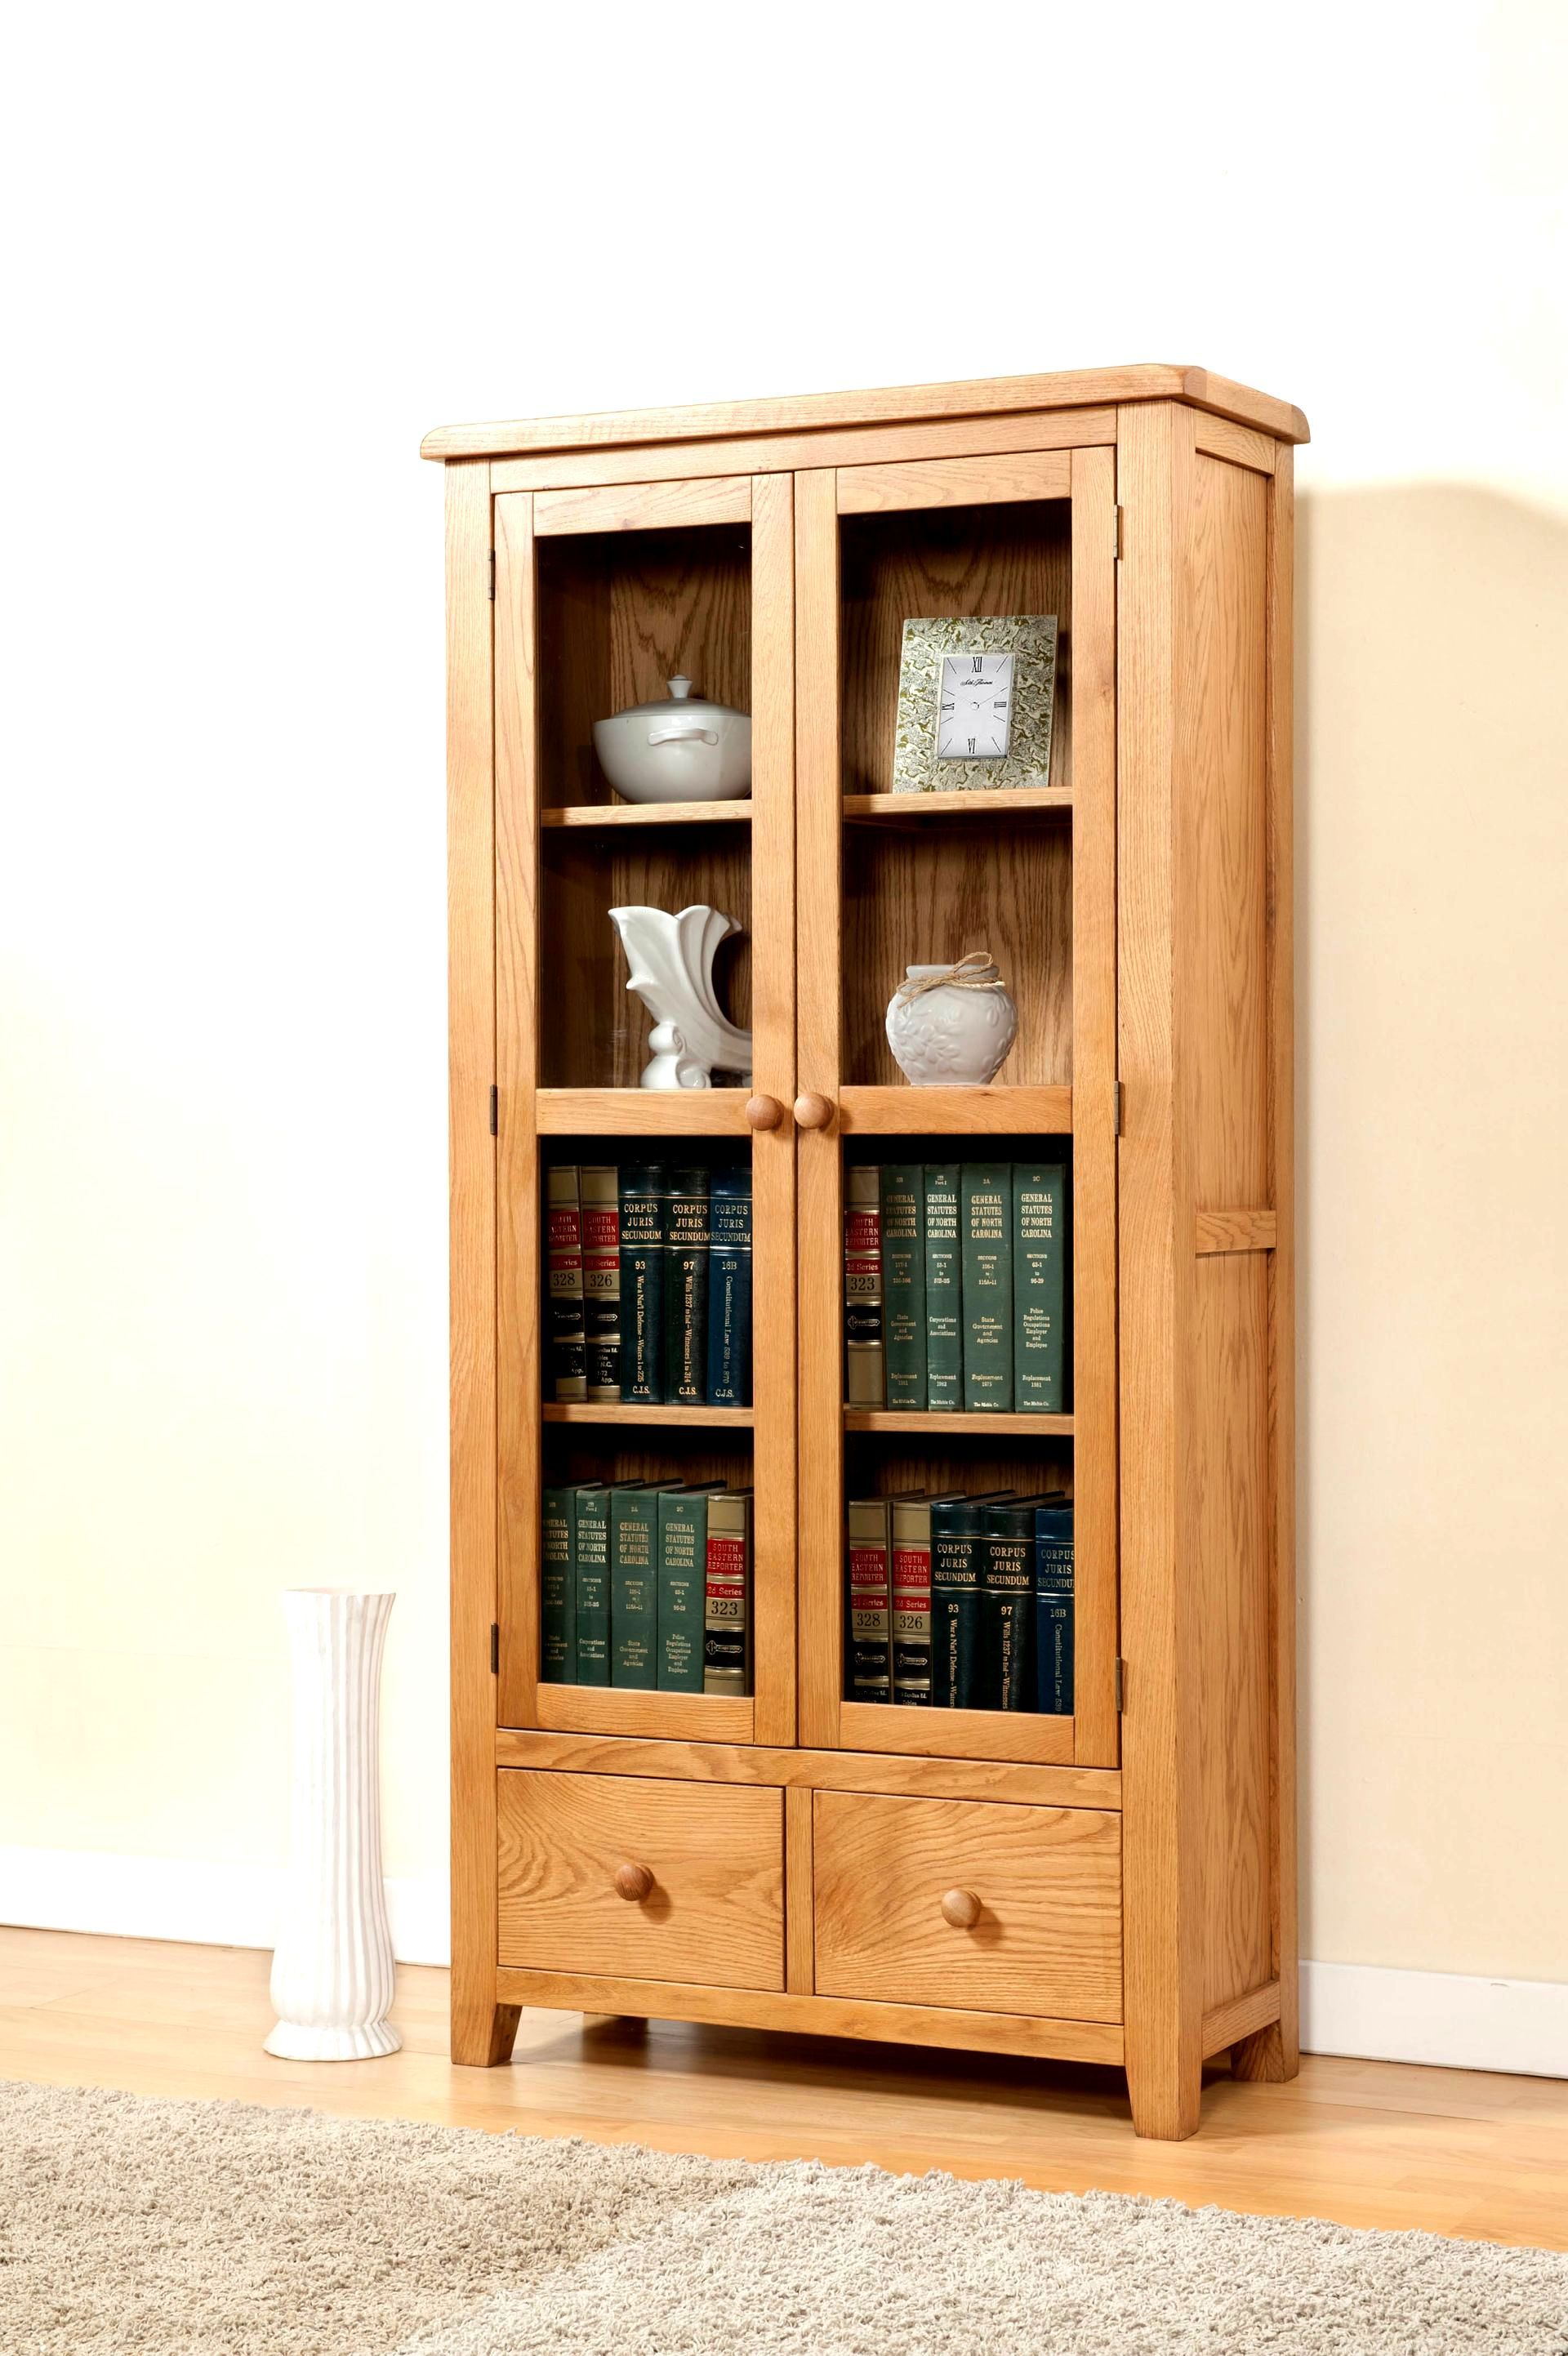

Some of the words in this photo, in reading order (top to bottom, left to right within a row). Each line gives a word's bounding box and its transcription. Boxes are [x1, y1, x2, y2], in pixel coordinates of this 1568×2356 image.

[972, 657, 982, 673] XII
[887, 1195, 915, 1203] GENERAL
[927, 1194, 957, 1203] GENERAL
[971, 1196, 1002, 1204] GENERAL
[1021, 1194, 1052, 1203] GENERAL
[624, 1204, 658, 1213] CORPUS
[672, 1205, 708, 1214] CORPUS
[715, 1205, 749, 1215] CORPUS
[887, 1206, 916, 1214] STATUTES
[927, 1206, 957, 1214] STATUTES
[971, 1207, 1003, 1216] STATUTES
[1021, 1205, 1053, 1214] STATUTES
[627, 1217, 653, 1227] JURIS
[675, 1218, 703, 1227] JURIS
[718, 1219, 744, 1228] JURIS
[896, 1218, 916, 1226] NORTH
[927, 1218, 935, 1226] OF
[936, 1218, 957, 1227] NORTH
[971, 1218, 979, 1227] OF
[982, 1218, 1003, 1227] NORTH
[1021, 1218, 1030, 1226] OF
[1031, 1218, 1052, 1226] NORTH
[621, 1231, 662, 1240] SECUNDUM
[669, 1231, 710, 1241] SECUNDUM
[711, 1232, 751, 1242] SECUNDUM
[887, 1229, 917, 1237] CAROLINA
[927, 1229, 957, 1238] CAROLINA
[971, 1230, 1003, 1238] CAROLINA
[1021, 1229, 1052, 1238] CAROLINA
[635, 1261, 646, 1270] 93
[683, 1262, 694, 1270] 97
[857, 1263, 879, 1272] Series
[554, 1273, 576, 1286] 328
[590, 1274, 612, 1288] 326
[685, 1276, 693, 1292] Wills
[851, 1276, 875, 1290] 323
[724, 1276, 733, 1328] Constitutional
[632, 1386, 651, 1394] C.J.S.
[679, 1387, 697, 1396] C.J.S.
[715, 1388, 734, 1397] C.J.S.
[577, 1520, 607, 1529] GENERAL
[620, 1522, 648, 1531] GENERAL
[666, 1523, 694, 1532] GENERAL
[577, 1531, 607, 1540] STATUTES
[620, 1534, 648, 1543] STATUTES
[666, 1534, 694, 1544] STATUTES
[586, 1543, 606, 1552] NORTH
[620, 1544, 627, 1552] OF
[666, 1546, 674, 1554] OF
[674, 1547, 694, 1556] NORTH
[712, 1543, 738, 1552] SOUTH
[938, 1543, 972, 1554] CORPUS
[990, 1547, 1026, 1557] CORPUS
[578, 1554, 606, 1563] CAROLINA
[620, 1556, 649, 1565] CAROLINA
[708, 1552, 743, 1561] EASTERN
[899, 1555, 923, 1564] SOUTH
[666, 1557, 694, 1567] CAROLINA
[708, 1561, 744, 1571] REPORTER
[941, 1558, 968, 1568] JURIS
[993, 1561, 1021, 1571] JURIS
[1045, 1564, 1072, 1574] JURIS
[934, 1572, 976, 1582] SECUNDUM
[987, 1574, 1030, 1585] SECUNDUM
[1037, 1577, 1075, 1588] SECUNDU
[719, 1587, 742, 1596] Series
[711, 1601, 738, 1615] 323
[906, 1600, 927, 1609] Series
[947, 1604, 959, 1613] 93
[1000, 1606, 1012, 1615] 97
[857, 1613, 880, 1627] 328
[899, 1614, 923, 1629] 326
[1003, 1621, 1011, 1639] Wills
[1054, 1623, 1062, 1677] Constitutional
